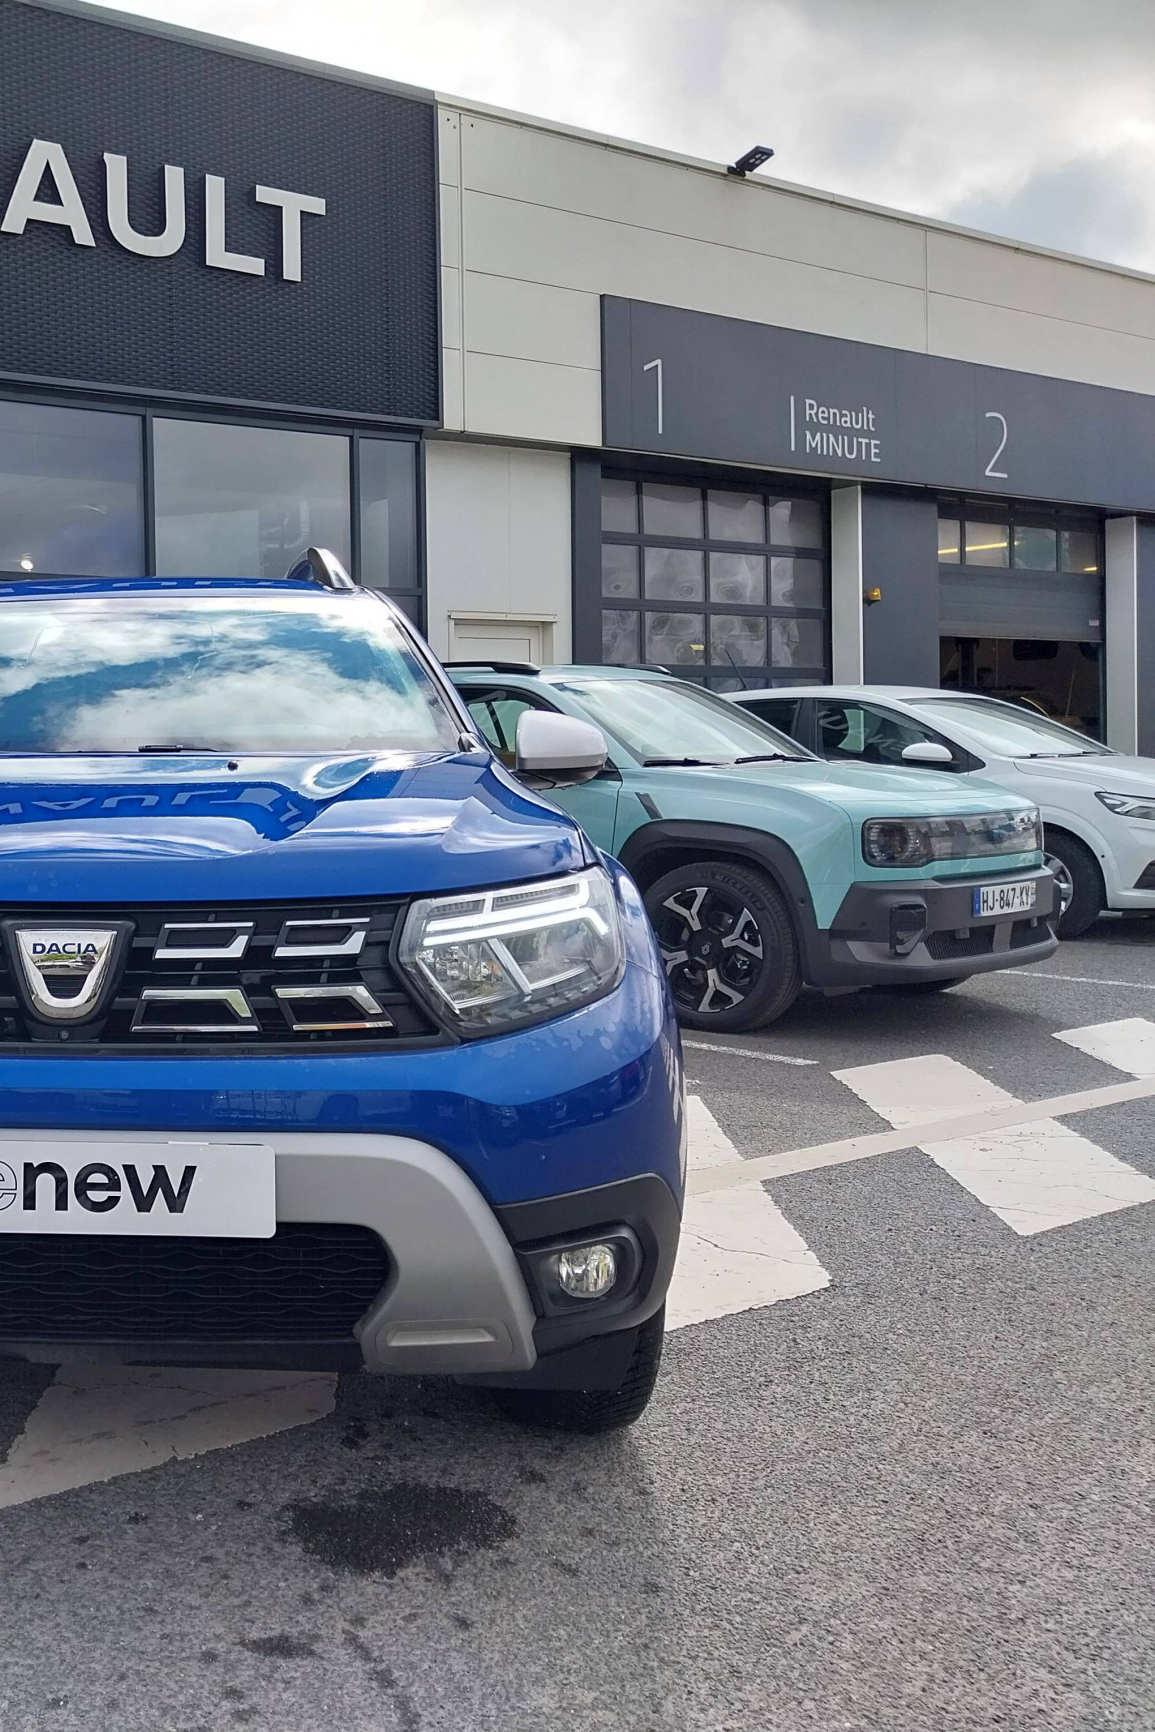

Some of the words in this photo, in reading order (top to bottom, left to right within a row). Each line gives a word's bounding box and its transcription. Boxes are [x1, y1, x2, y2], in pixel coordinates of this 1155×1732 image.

[643, 358, 663, 435] 1
[805, 398, 875, 431] Renault
[805, 430, 881, 462] MINUTE
[983, 411, 1009, 479] 2
[981, 885, 1030, 912] HJ-847-KY
[32, 943, 98, 954] DACIA
